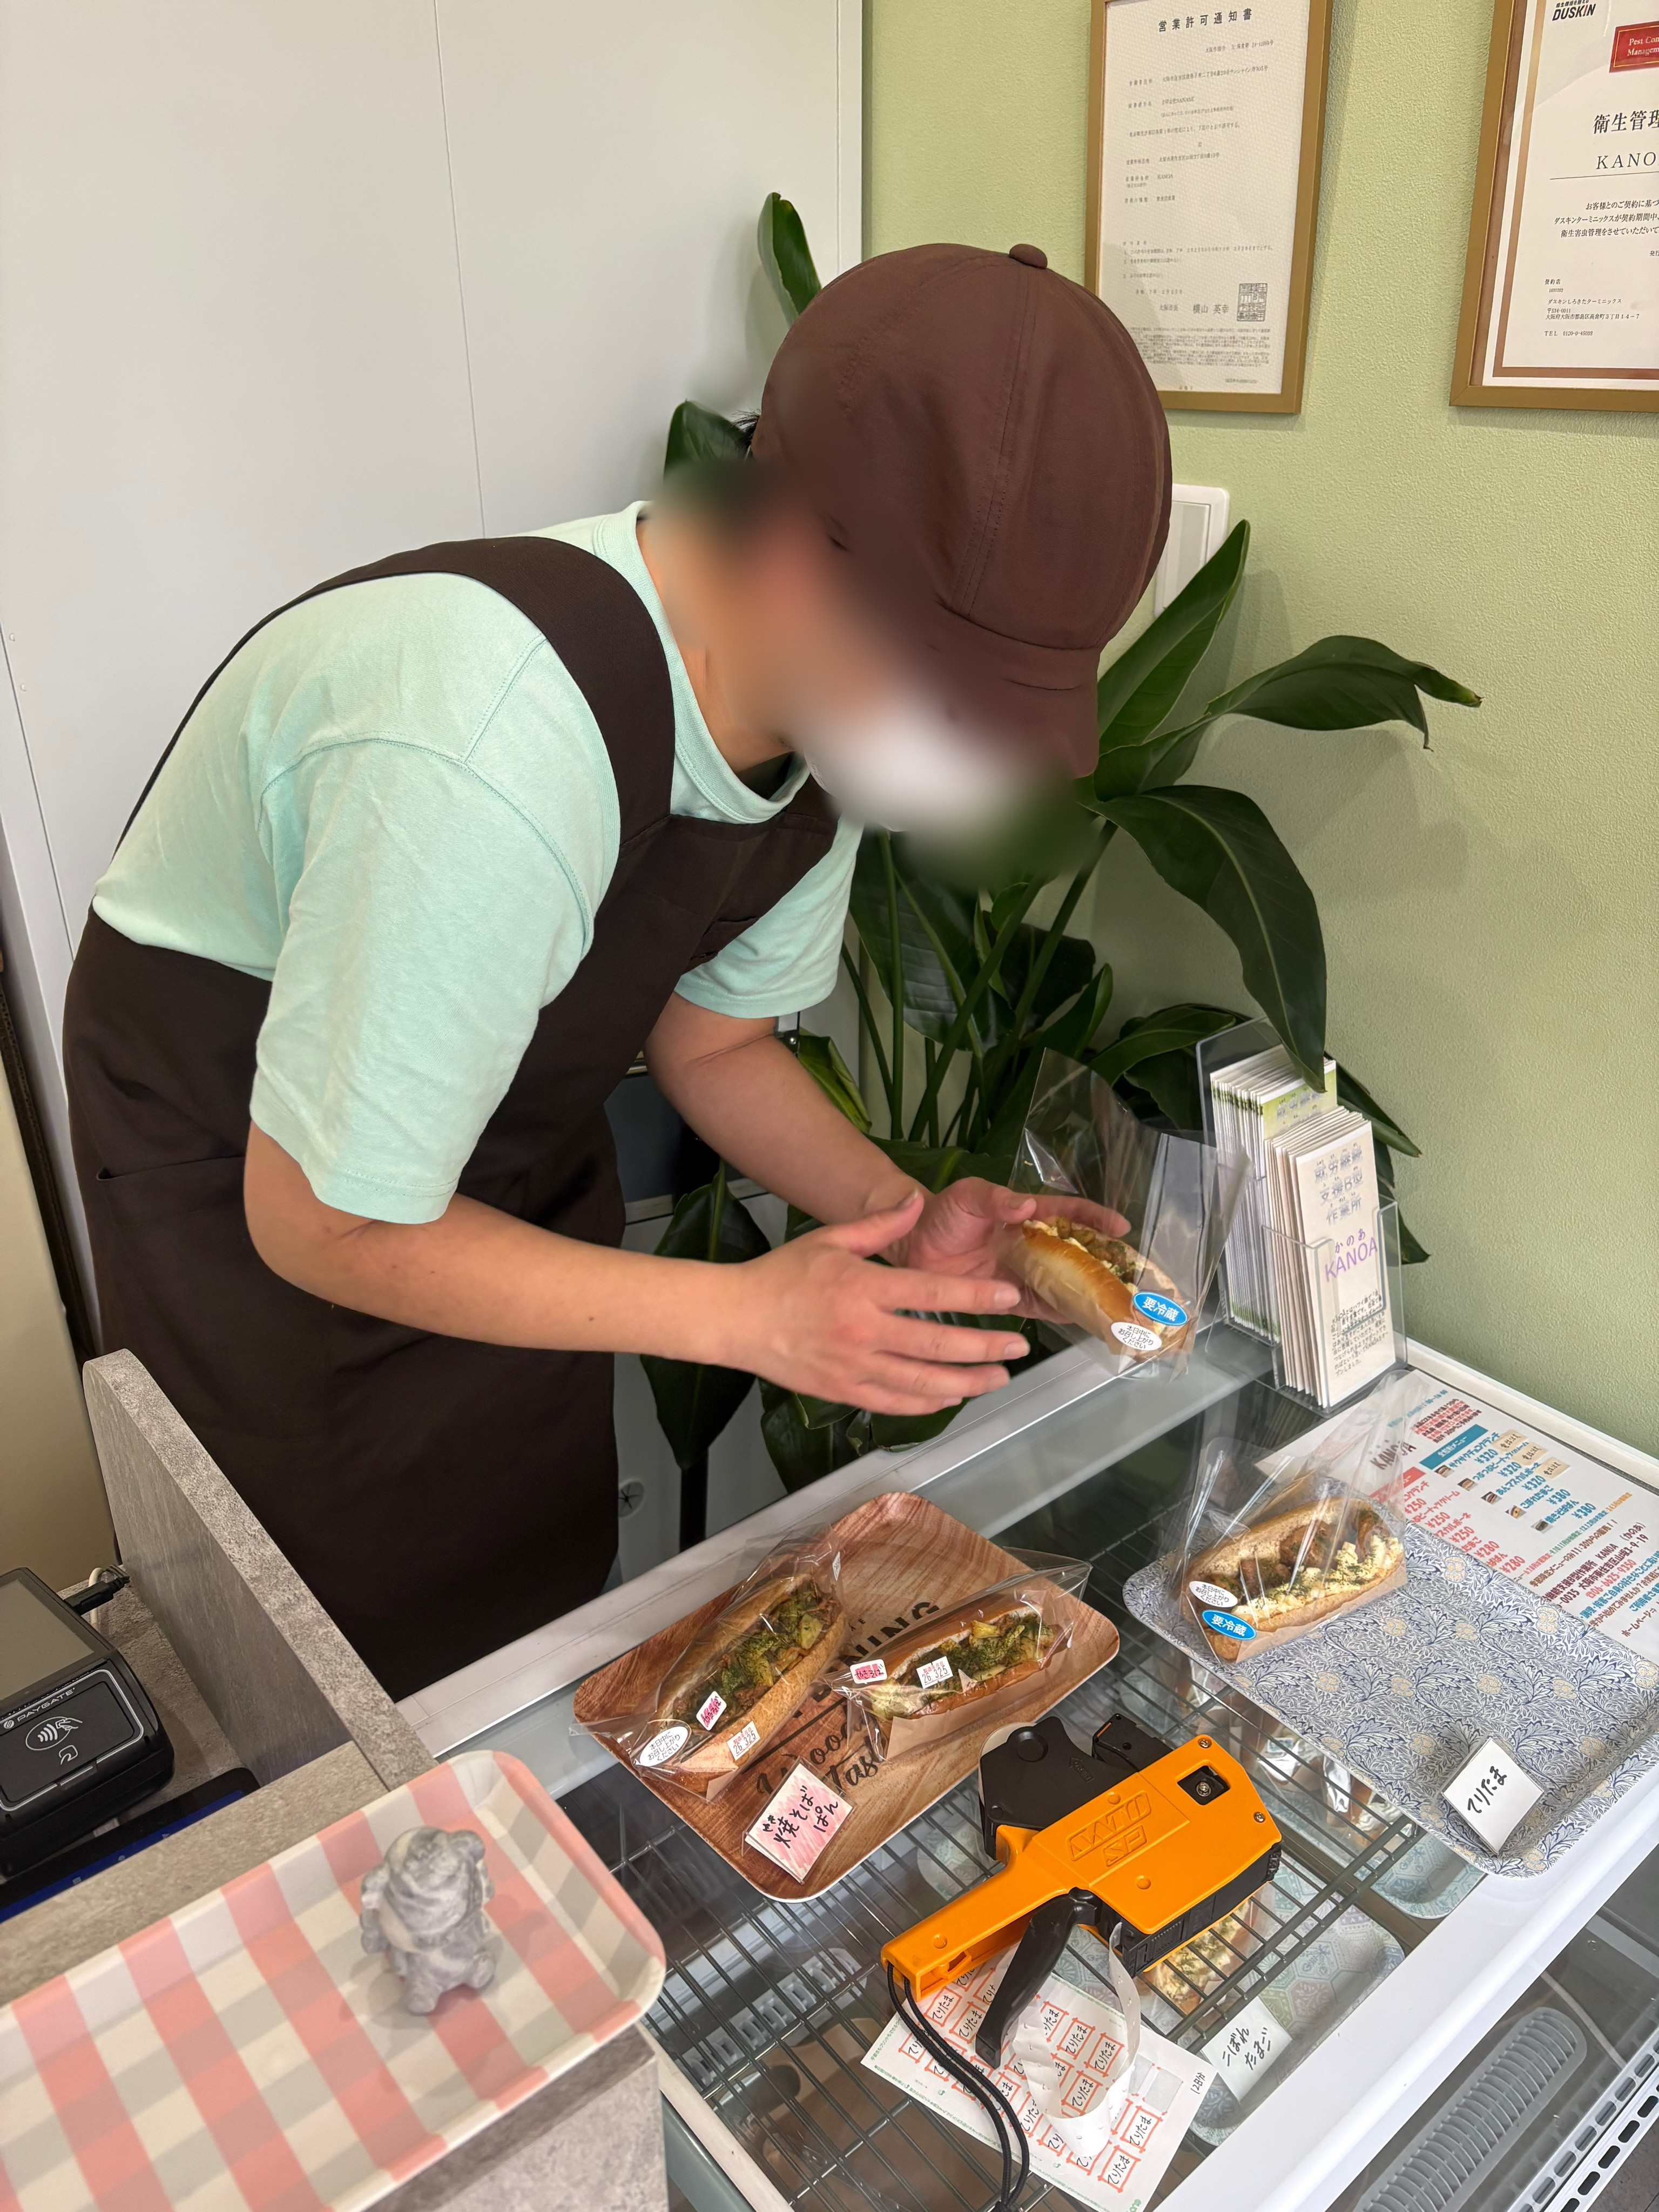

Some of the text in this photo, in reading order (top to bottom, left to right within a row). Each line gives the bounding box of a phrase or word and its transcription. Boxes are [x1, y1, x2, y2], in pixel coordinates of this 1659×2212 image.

[1158, 8, 1252, 32] 営業許可通知書
[1552, 4, 1596, 21] DUSKIN
[1629, 38, 1643, 46] Pest
[1593, 110, 1659, 134] 衛生管理
[1596, 152, 1659, 170] KANO
[1193, 304, 1208, 314] 横山
[1336, 1228, 1366, 1253] かのあ
[1325, 1237, 1378, 1282] KANOA
[1142, 1297, 1179, 1321] 要冷蔵
[1118, 1328, 1154, 1346] お召し上がり
[1127, 1325, 1151, 1338] 本日中に
[1123, 1337, 1146, 1349] ください
[1474, 1449, 1498, 1464] ¥320
[1498, 1462, 1522, 1478] ¥320
[1521, 1475, 1546, 1491] ¥320
[1546, 1489, 1570, 1505] ¥380
[1425, 1512, 1450, 1528] ¥250
[1571, 1503, 1596, 1519] ¥380
[1449, 1526, 1475, 1543] ¥250
[1474, 1541, 1500, 1558] ¥280
[1595, 1543, 1619, 1560] KANOA
[1499, 1556, 1526, 1573] ¥280
[1196, 1587, 1229, 1602] お召し上がり
[1202, 1584, 1225, 1596] 本日中に
[1558, 1589, 1580, 1607] -0035
[1201, 1595, 1223, 1606] ください
[1211, 1614, 1247, 1637] 要冷蔵
[854, 1663, 885, 1680] やきそば
[17, 1688, 73, 1721] PAYGATE
[648, 1734, 680, 1761] お召し上がり
[650, 1731, 673, 1750] 本日中に
[657, 1744, 679, 1761] ください
[1468, 1766, 1507, 1813] てりたま
[773, 1785, 814, 1849] 焼そば
[814, 1800, 839, 1832] ぱん
[1069, 1790, 1153, 1862] SATO
[1102, 1825, 1147, 1866] SP
[933, 1994, 954, 2020] てりたま
[960, 2010, 983, 2038] てりたま
[1046, 2008, 1060, 2036] りたま
[1065, 2025, 1088, 2054] てりたま
[1222, 2027, 1250, 2067] こぼれ
[1244, 2027, 1271, 2071] たまご
[1095, 2041, 1116, 2071] てりたま
[1072, 2078, 1094, 2108] てりたま
[1020, 2100, 1040, 2132] てりた
[1130, 2115, 1152, 2147] てりたま
[1047, 2134, 1063, 2150] てり
[1108, 2154, 1131, 2185] てりたま
